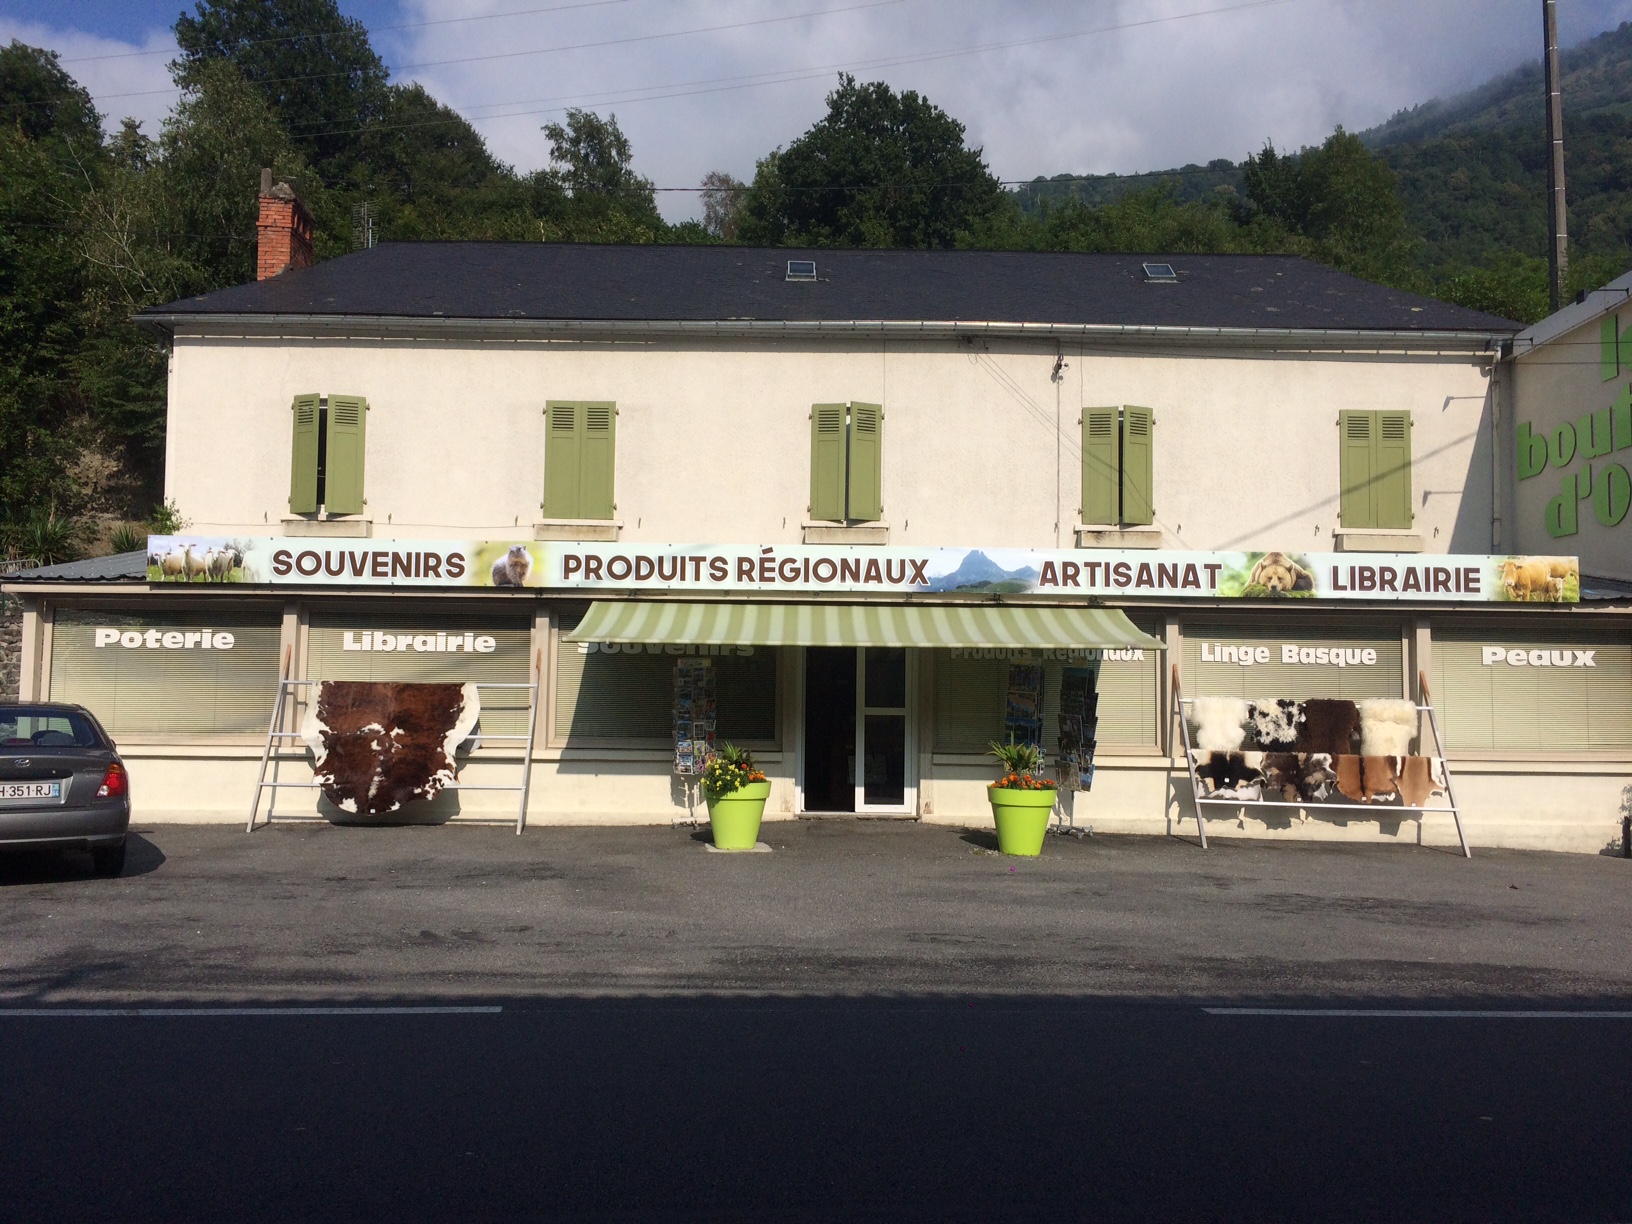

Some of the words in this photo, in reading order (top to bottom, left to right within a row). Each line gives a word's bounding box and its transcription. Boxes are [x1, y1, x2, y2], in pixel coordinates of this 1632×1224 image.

[272, 549, 466, 579] SOUVENIRS
[563, 554, 729, 582] PRODUITS
[736, 547, 929, 586] RÉGIONAUX
[1039, 561, 1222, 590] ARTISANAT
[1332, 565, 1481, 594] LIBRAIRIE
[94, 628, 235, 650] Poterie
[342, 631, 496, 654] Librairie
[1200, 643, 1270, 666] Linge
[1281, 644, 1378, 668] Basque
[1482, 645, 1596, 668] Peaux
